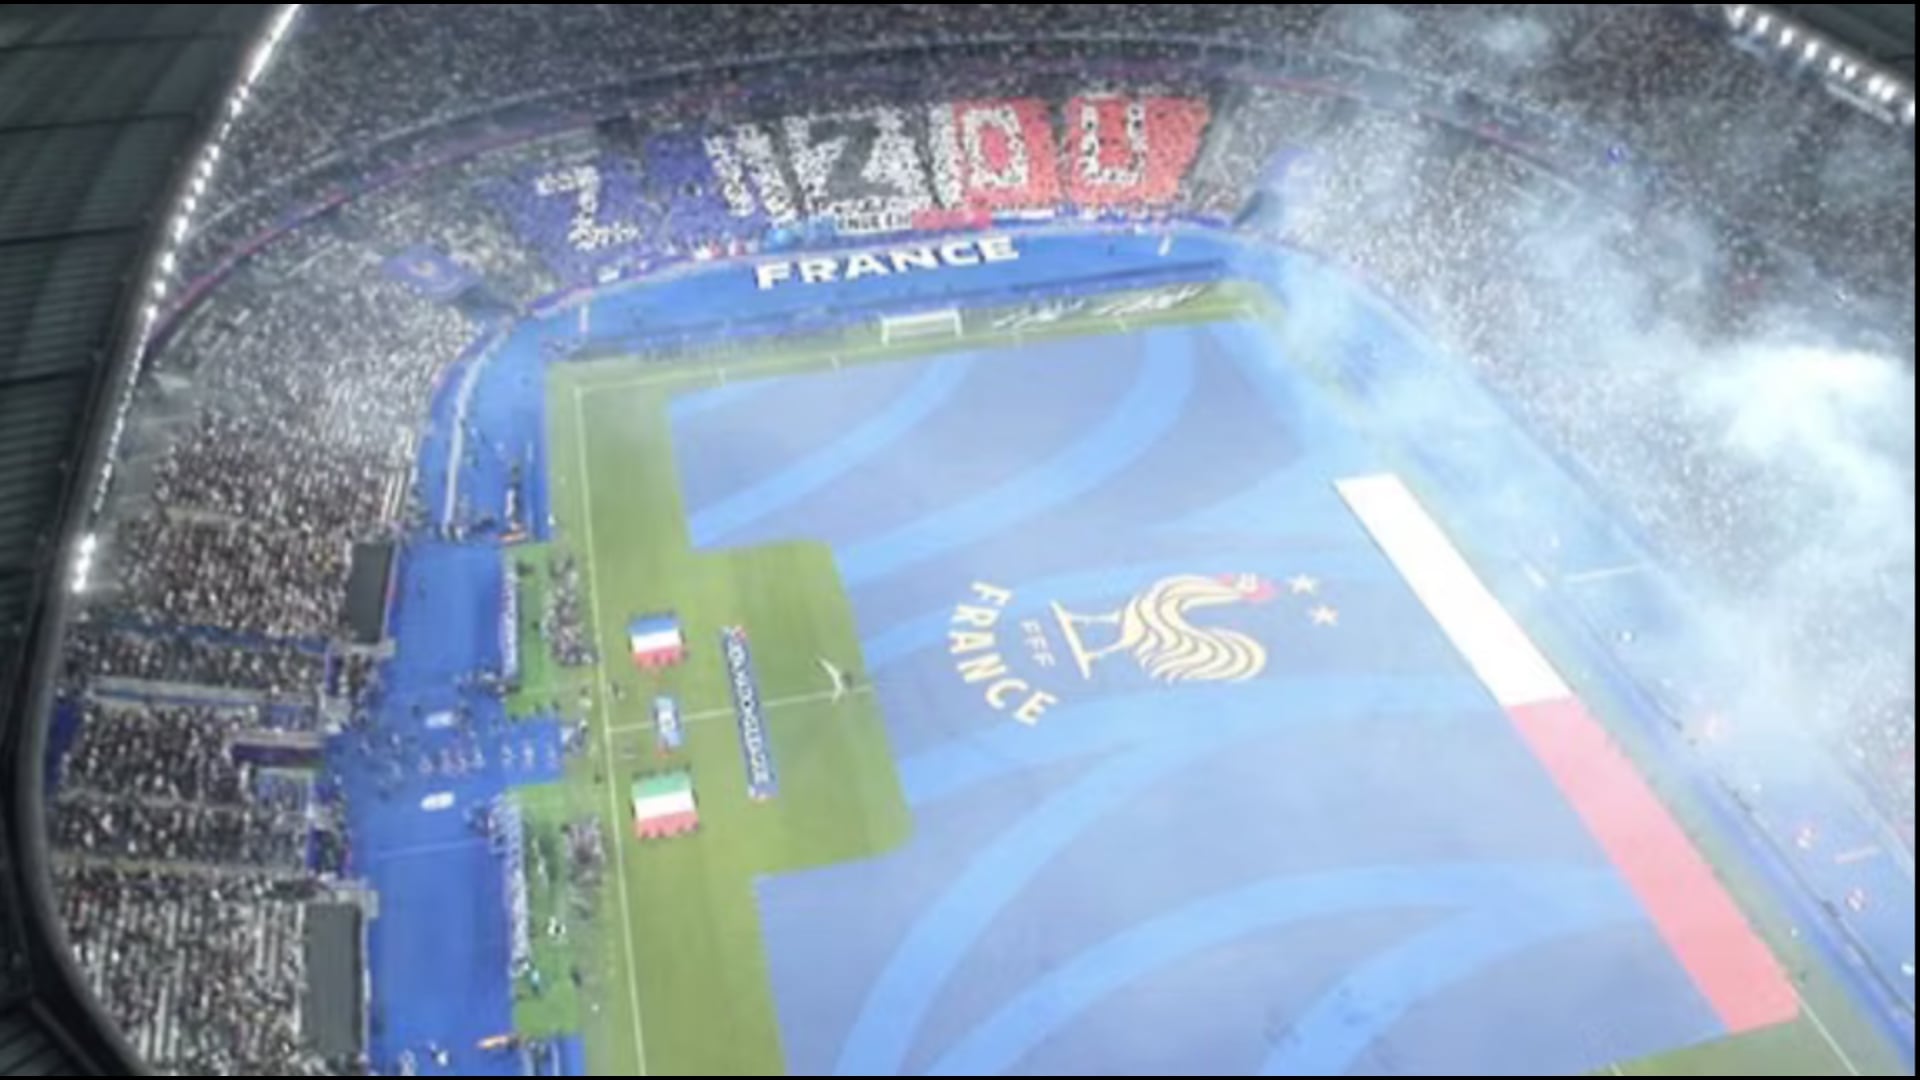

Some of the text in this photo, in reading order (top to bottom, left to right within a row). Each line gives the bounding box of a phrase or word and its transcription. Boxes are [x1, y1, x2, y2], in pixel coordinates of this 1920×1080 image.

[756, 235, 1020, 290] FRANCE
[949, 580, 1058, 726] FRANCE
[1022, 619, 1055, 668] FFF
